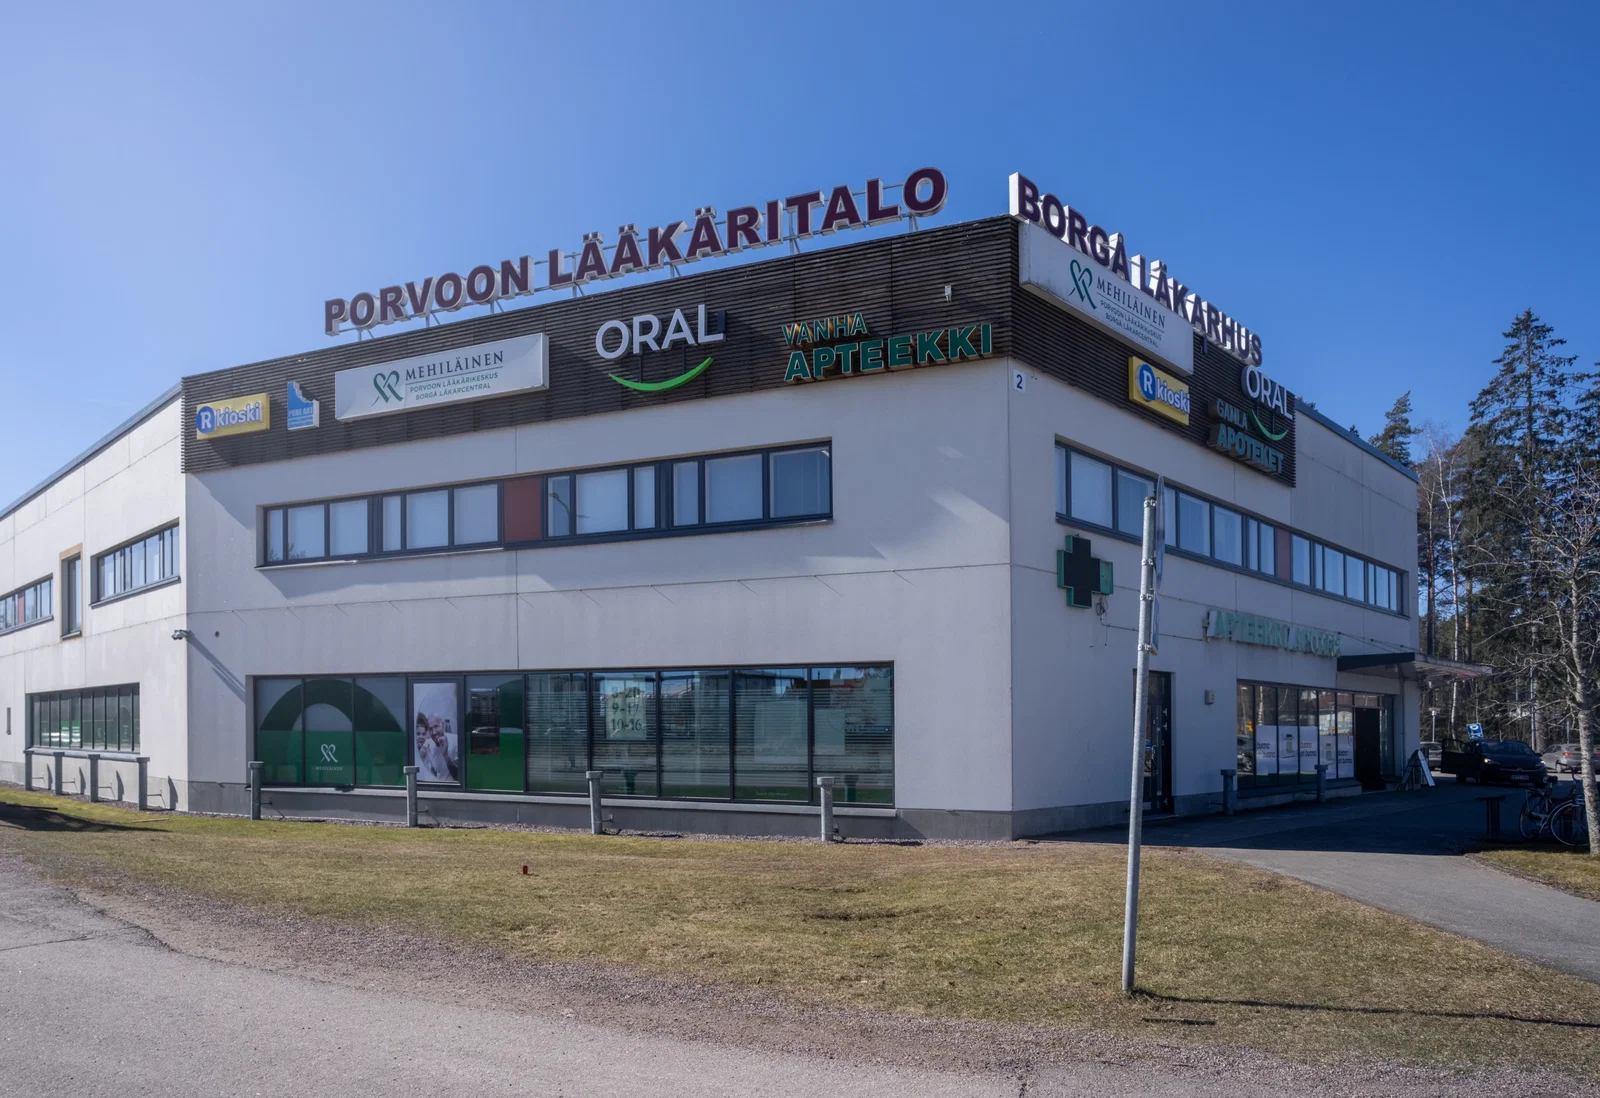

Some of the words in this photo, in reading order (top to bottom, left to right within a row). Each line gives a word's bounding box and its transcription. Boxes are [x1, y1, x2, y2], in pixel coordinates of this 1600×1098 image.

[325, 255, 534, 337] PORVOON
[549, 166, 949, 290] LÄÄKÄRITALO
[1010, 172, 1131, 282] BORGÅ
[1132, 254, 1263, 368] LÄKARHUS
[1096, 275, 1166, 328] MEHILÄINEN
[1100, 299, 1124, 318] PORVOON
[595, 303, 726, 360] ORAL
[782, 312, 868, 346] VANHA
[405, 350, 504, 381] MEHILÄINEN
[783, 323, 993, 382] APTEEKKI
[410, 383, 441, 393] PORVOON
[442, 372, 499, 388] LÄÄKÄRIKESKUS
[415, 391, 438, 401] BORGÅ
[439, 382, 491, 397] LÄKARCENTRAL
[1016, 374, 1024, 390] 2
[1156, 376, 1191, 415] kioski
[1244, 364, 1293, 420] ORAL
[215, 401, 264, 427] kioski
[1216, 398, 1248, 431] GAMLA
[1216, 421, 1285, 474] APOTEKET
[611, 718, 642, 731] 10-16
